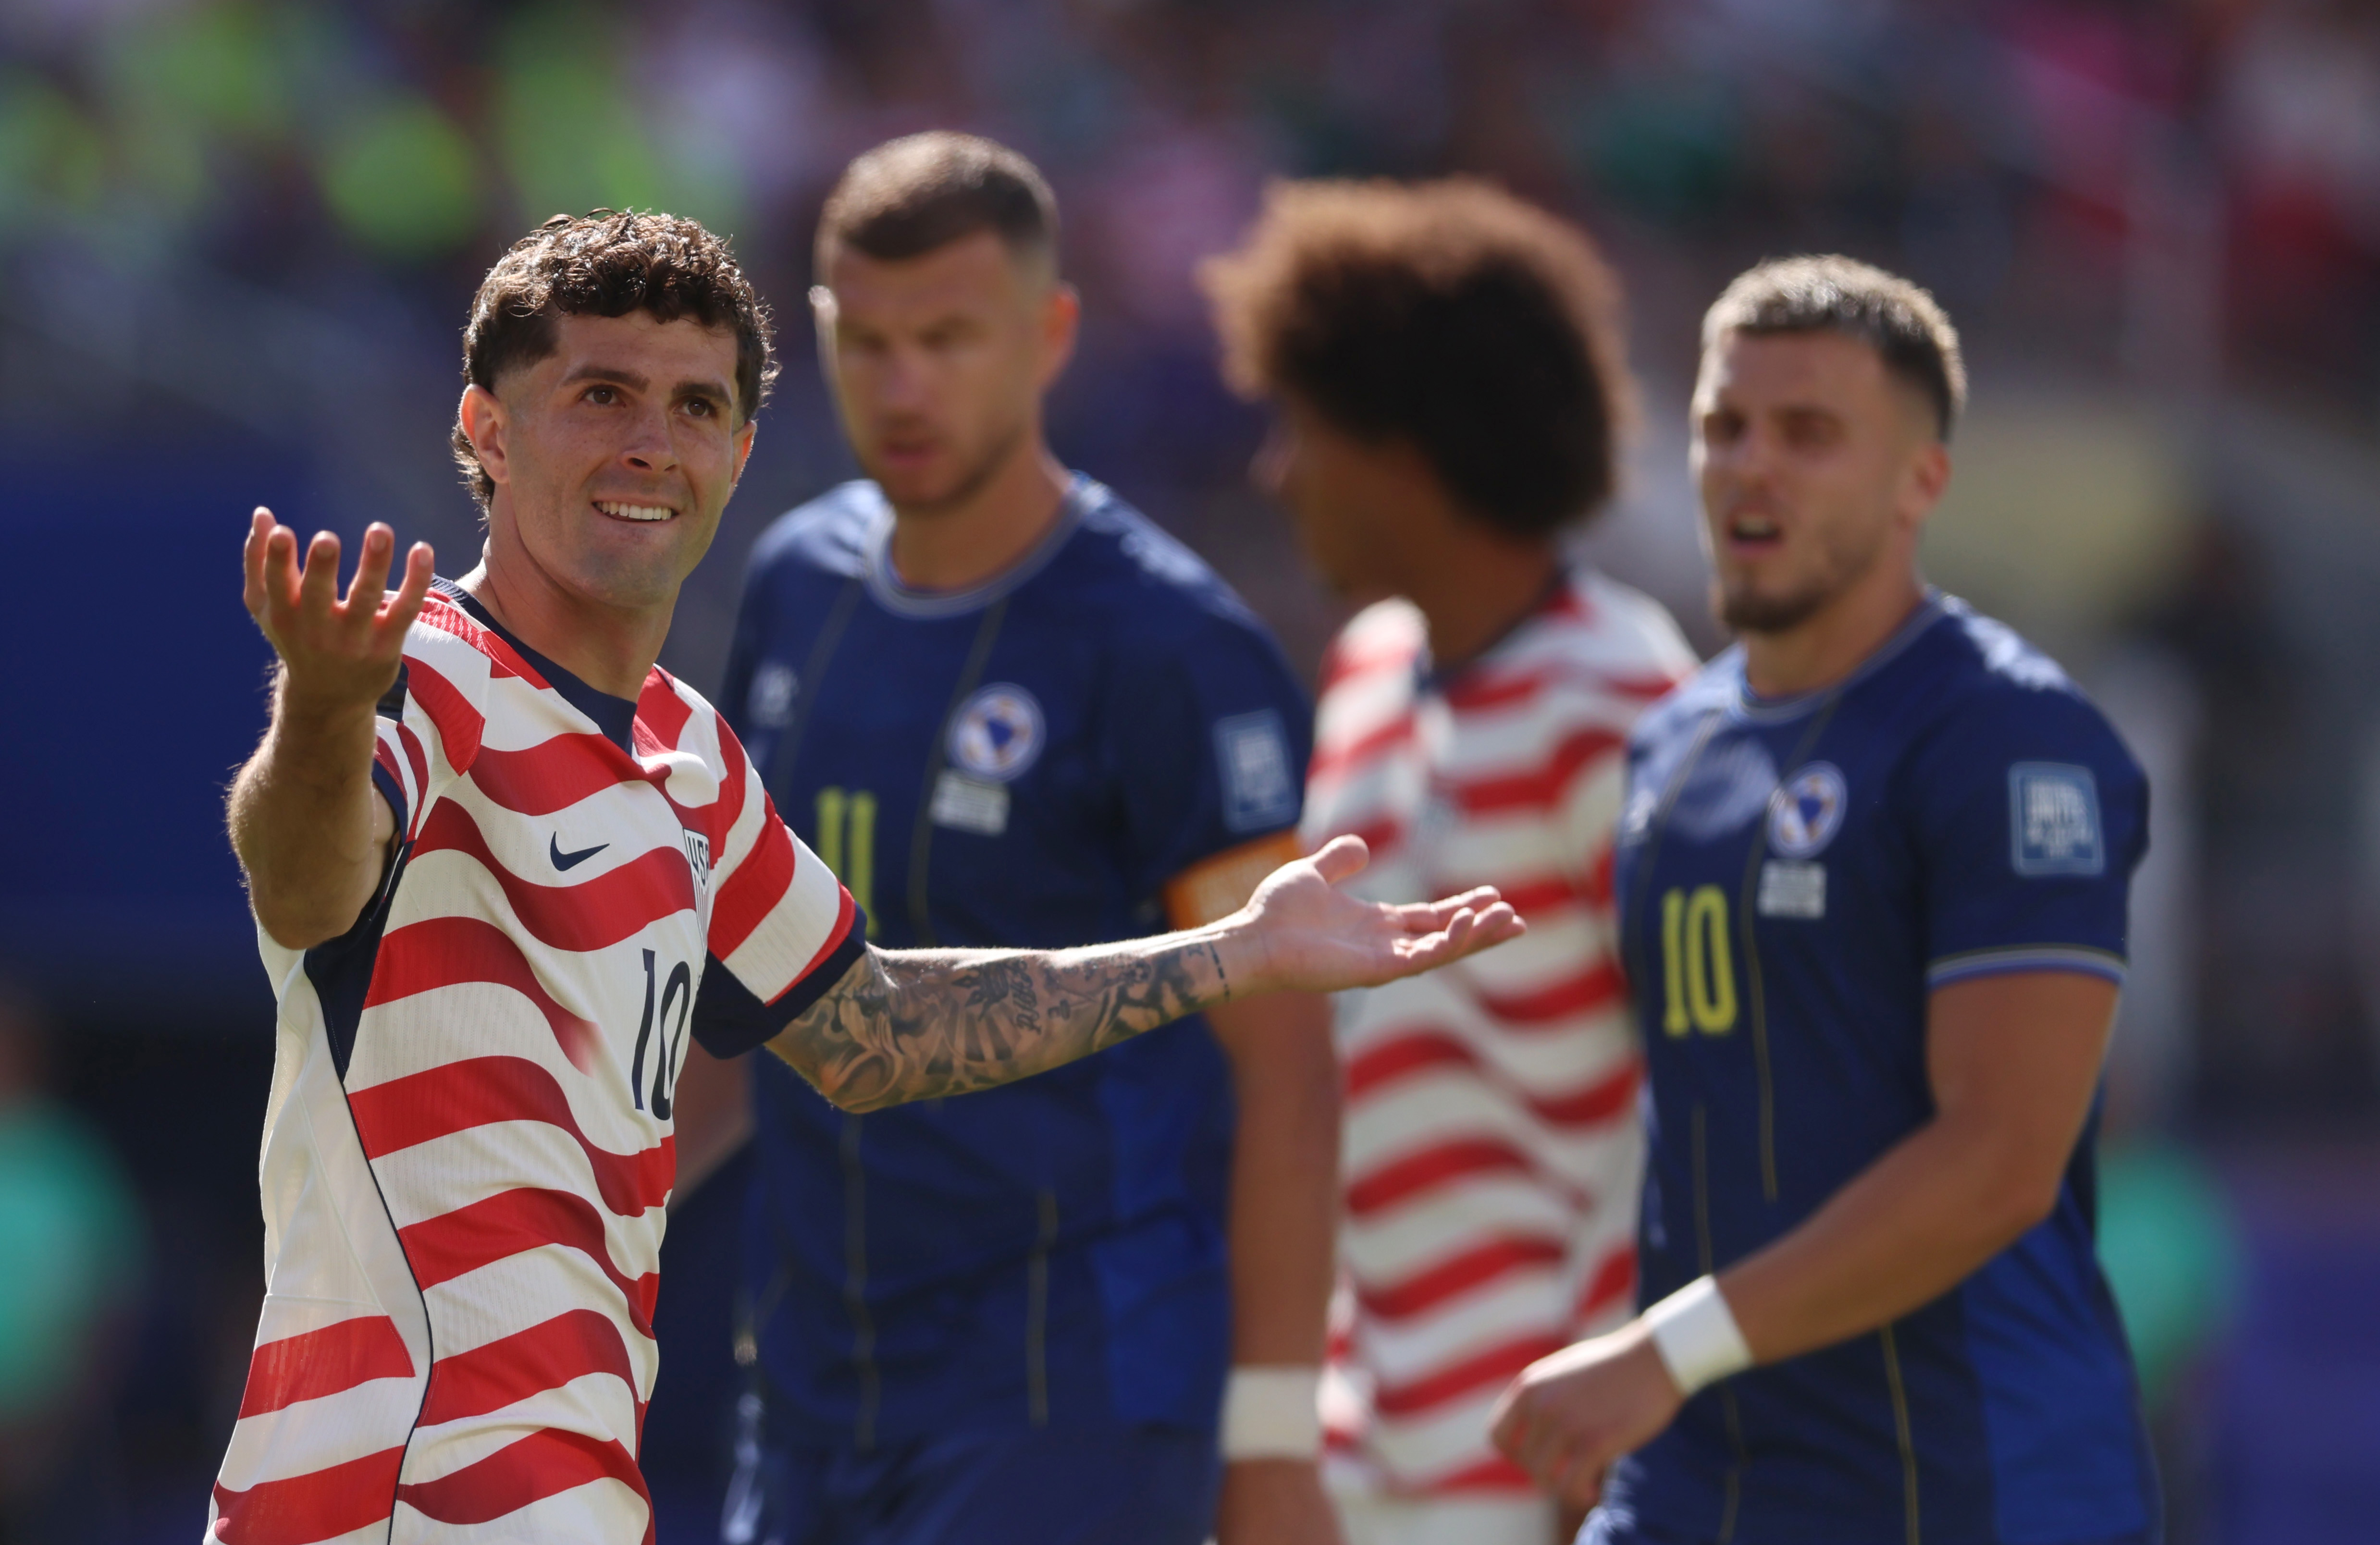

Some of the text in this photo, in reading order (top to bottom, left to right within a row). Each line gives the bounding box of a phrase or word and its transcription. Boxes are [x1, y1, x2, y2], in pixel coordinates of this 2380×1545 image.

[818, 788, 876, 937] 11
[632, 948, 691, 1121] 10
[1663, 886, 1737, 1036] 10
